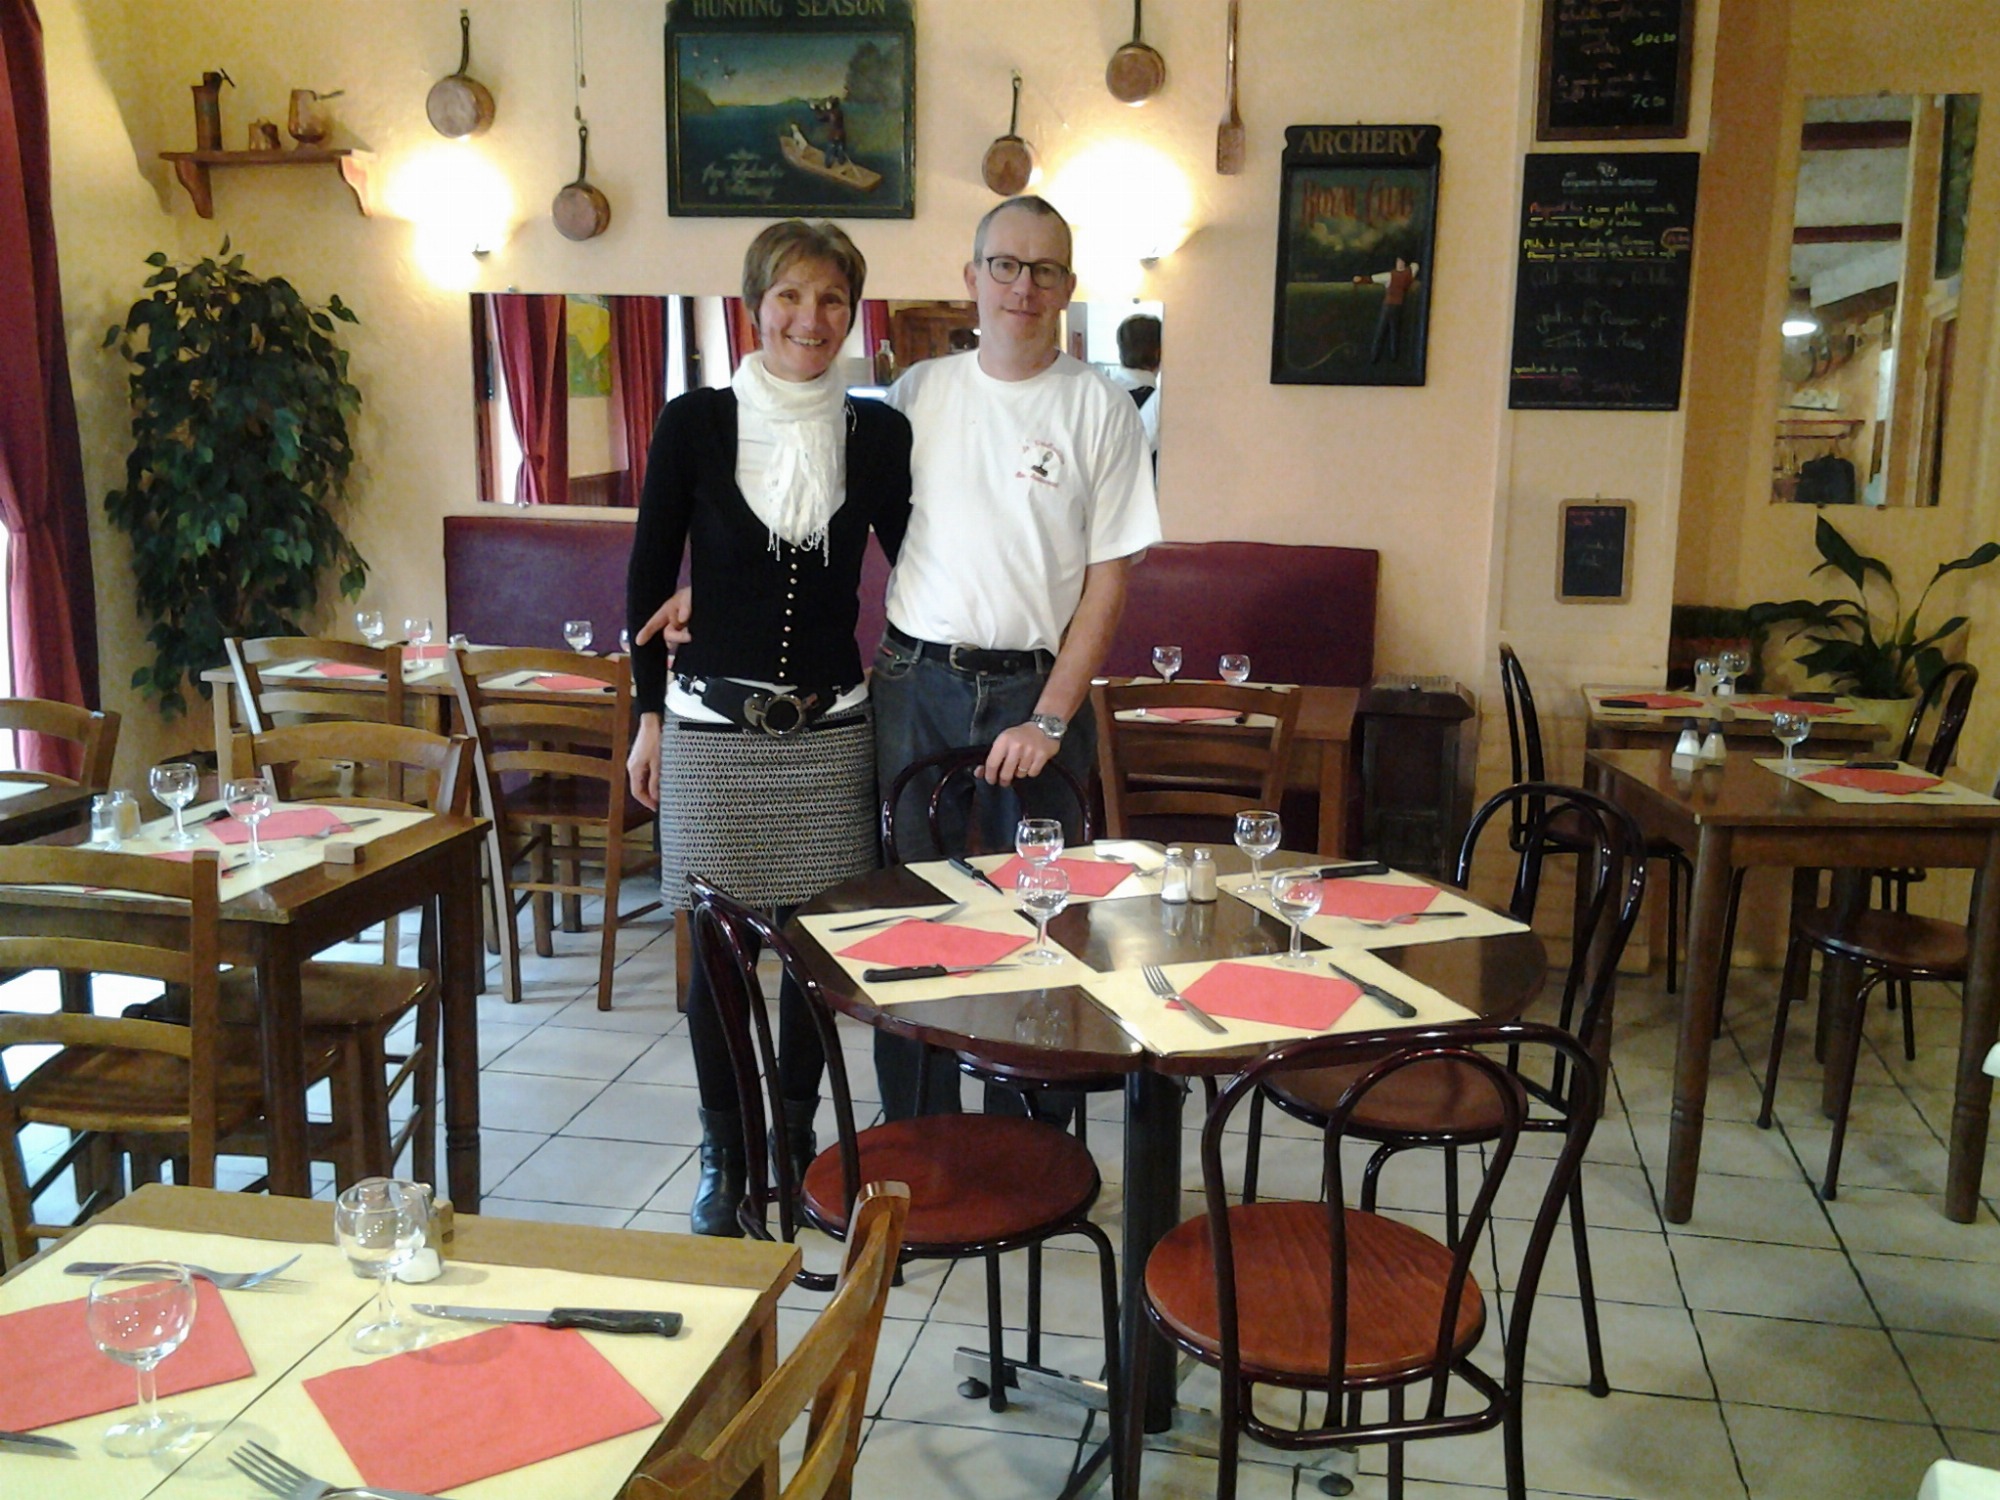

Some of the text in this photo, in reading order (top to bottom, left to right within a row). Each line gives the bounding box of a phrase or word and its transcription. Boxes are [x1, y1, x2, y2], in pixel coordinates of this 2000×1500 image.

[694, 0, 886, 17] HUNTING SEASON
[1299, 129, 1428, 155] ARCHERY
